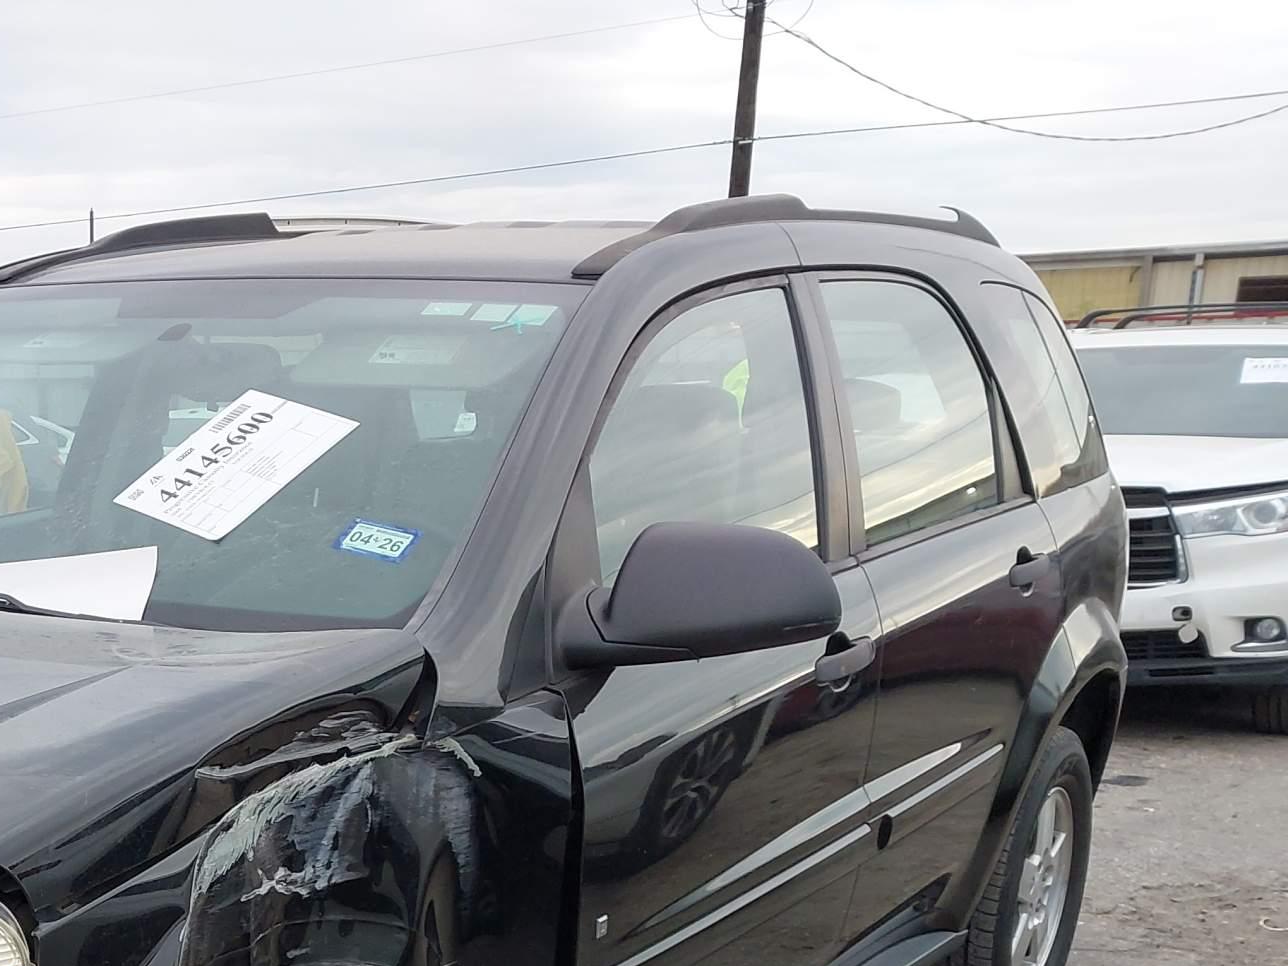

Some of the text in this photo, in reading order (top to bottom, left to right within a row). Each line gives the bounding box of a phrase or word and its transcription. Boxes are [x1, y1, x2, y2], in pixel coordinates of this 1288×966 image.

[160, 411, 273, 503] 44145600
[349, 530, 373, 545] 04
[377, 537, 404, 553] 26
